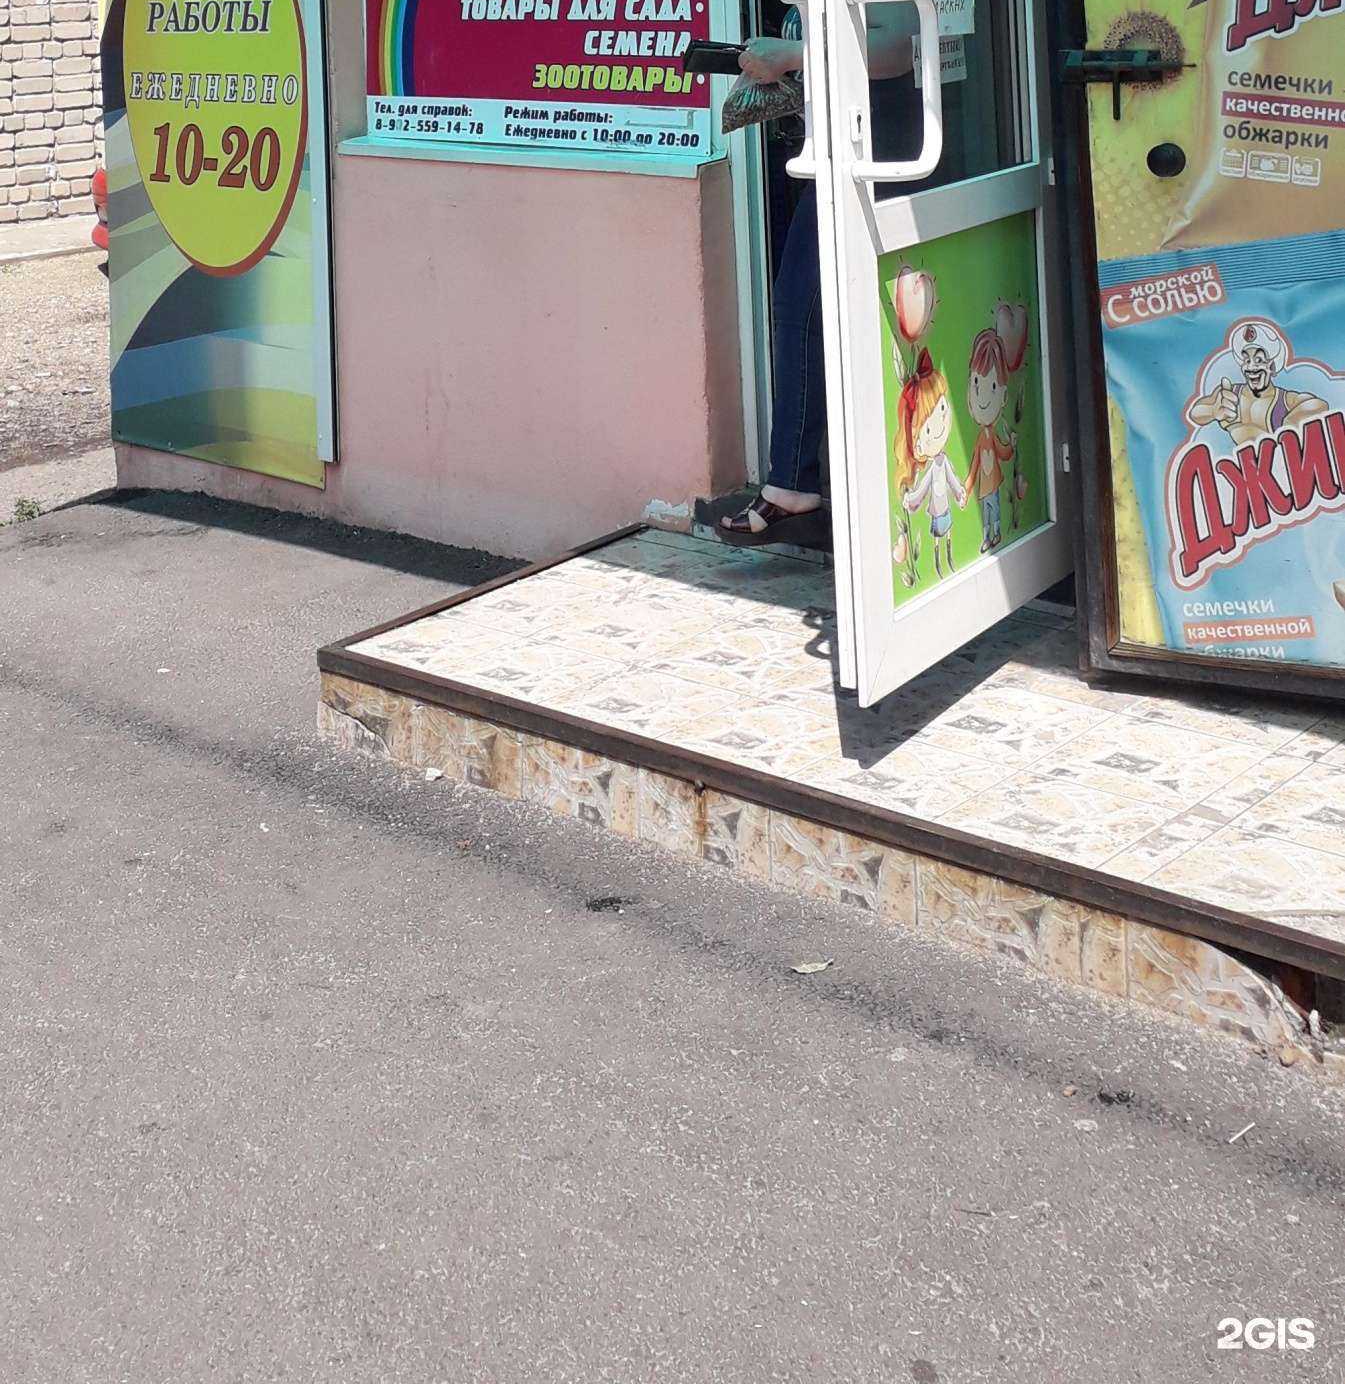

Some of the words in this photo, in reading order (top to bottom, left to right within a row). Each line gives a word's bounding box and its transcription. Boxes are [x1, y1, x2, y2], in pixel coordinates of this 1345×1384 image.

[146, 0, 273, 34] РАБОТЫ
[584, 29, 692, 57] СЕМЕНА
[130, 71, 299, 109] ЕЖЕДНЕВНО
[532, 64, 693, 94] ЗООТОВАРЫ
[1228, 71, 1333, 95] семечки
[375, 102, 395, 114] Тел.
[398, 104, 418, 116] для
[421, 104, 473, 118] справок:
[504, 106, 550, 121] Режим
[553, 109, 613, 124] работы:
[375, 118, 484, 134] 8-92-559-14-78
[504, 124, 577, 141] Ежедневно
[581, 130, 587, 141] с
[592, 129, 632, 143] 10:00
[636, 133, 653, 146] до
[658, 132, 700, 148] 20:00
[1223, 120, 1329, 150] обжарки
[148, 122, 281, 192] 10-20
[1129, 266, 1214, 298] морской
[1183, 598, 1275, 617] семечки
[1187, 619, 1311, 640] качественной
